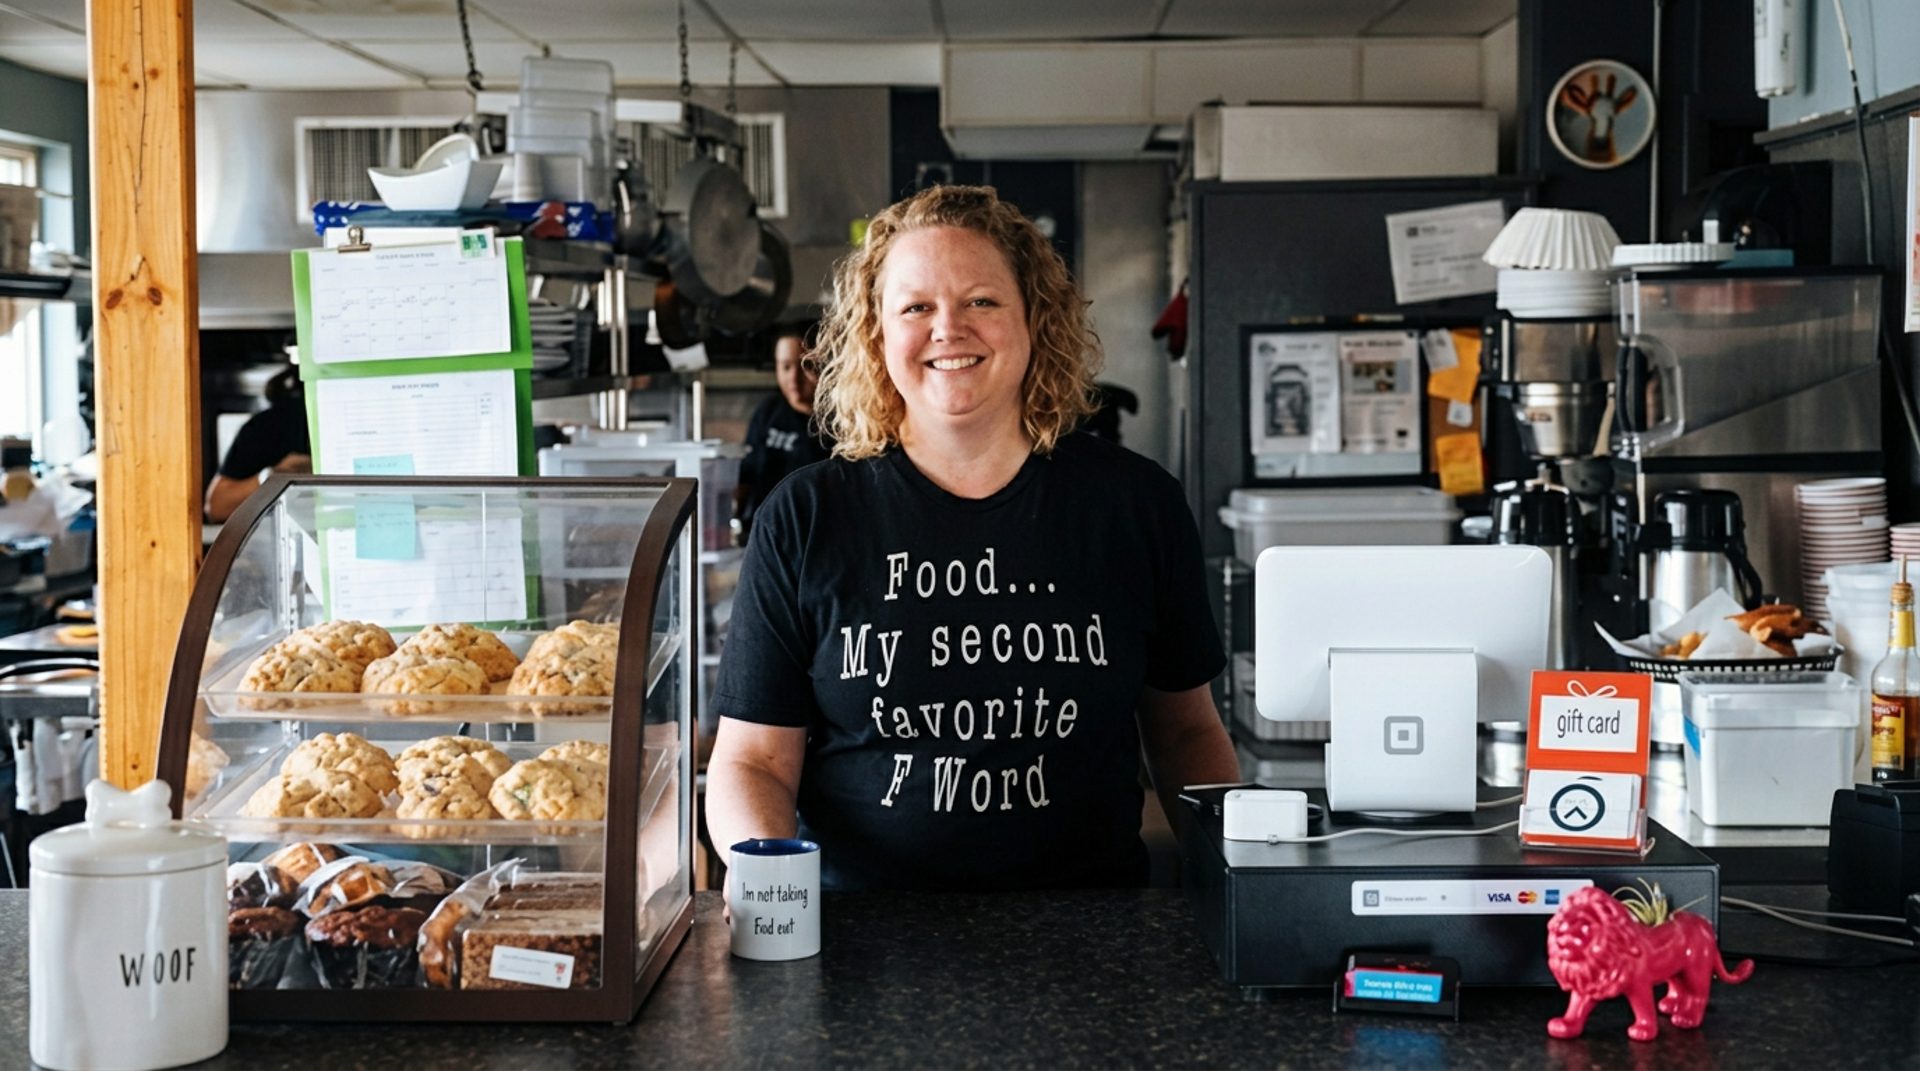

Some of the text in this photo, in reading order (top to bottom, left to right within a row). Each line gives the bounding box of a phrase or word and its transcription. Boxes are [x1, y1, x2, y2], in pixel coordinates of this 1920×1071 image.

[884, 548, 1056, 601] Food...
[840, 614, 1108, 687] My second
[871, 687, 1078, 741] favorite
[1557, 708, 1621, 738] gift card
[881, 754, 1050, 812] F Word
[777, 884, 809, 909] taking
[1487, 893, 1512, 903] VISA
[119, 947, 197, 988] WOOF
